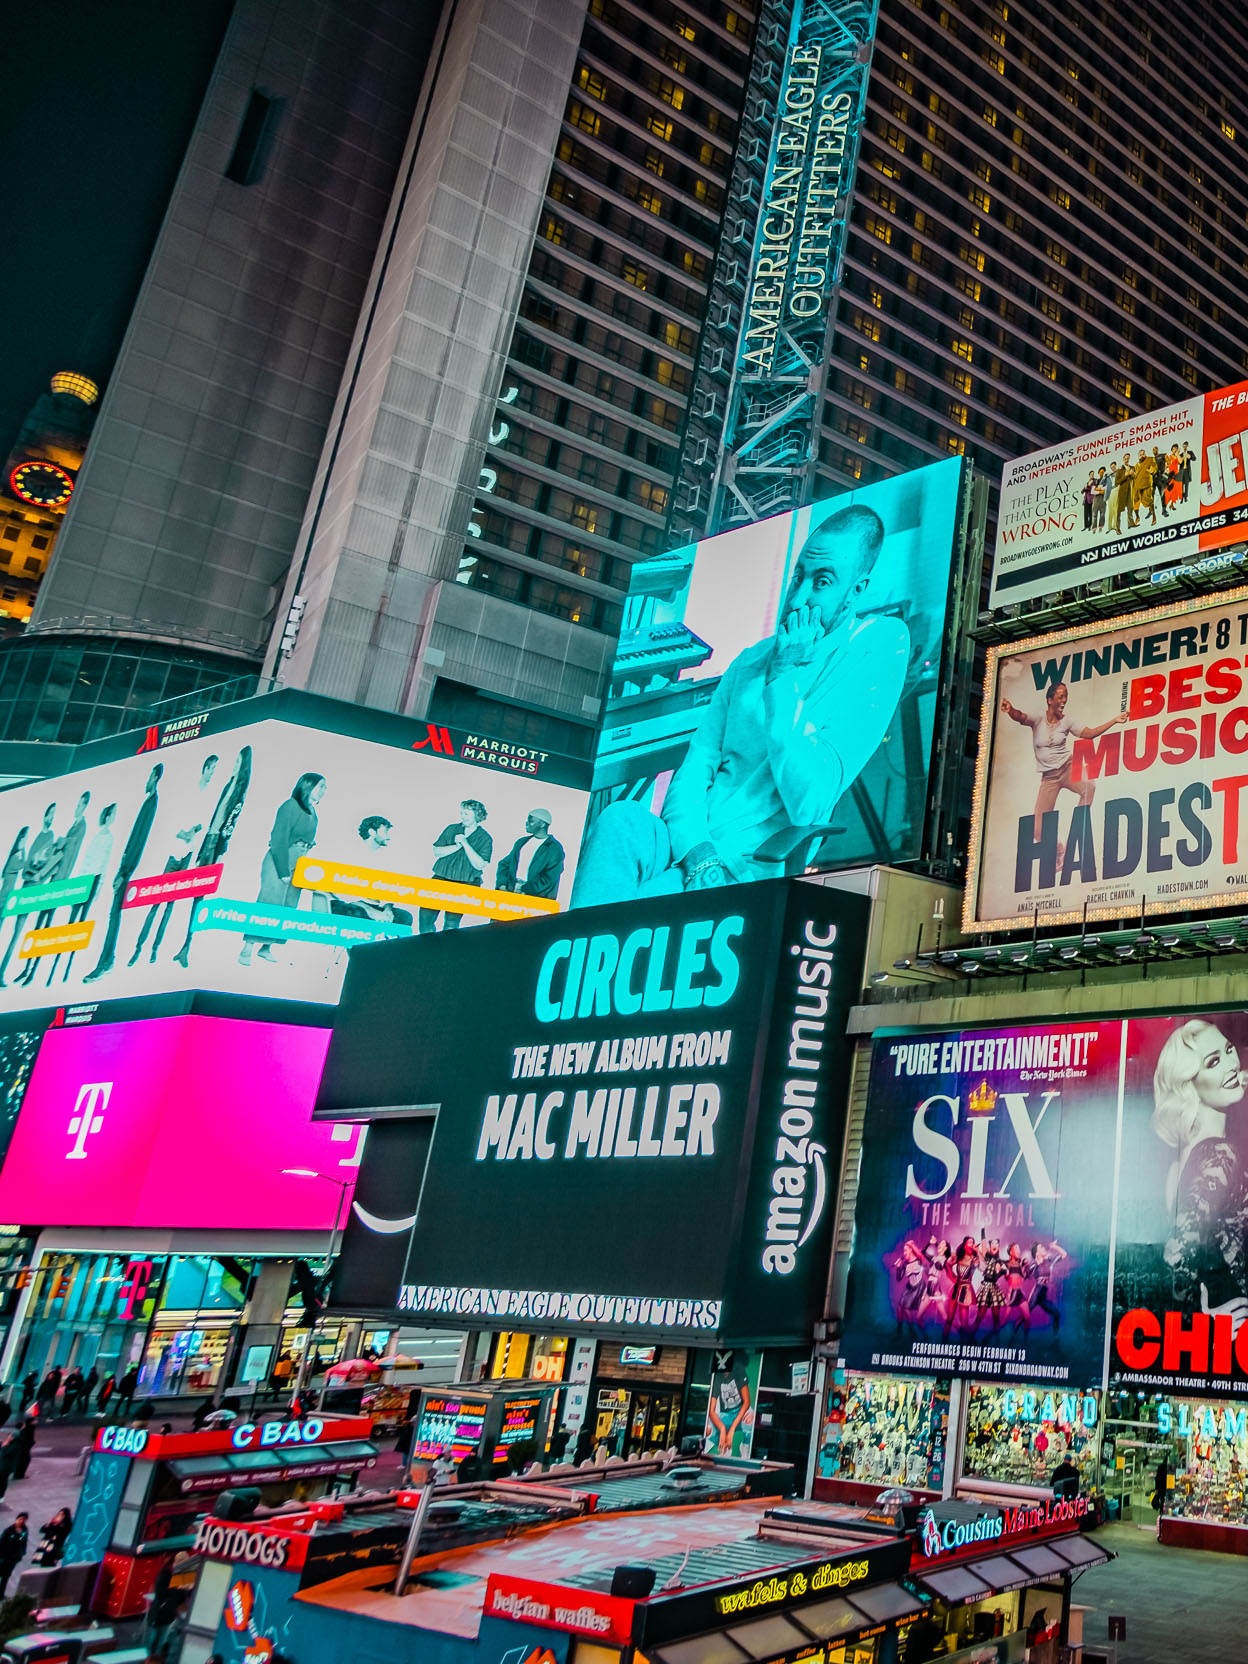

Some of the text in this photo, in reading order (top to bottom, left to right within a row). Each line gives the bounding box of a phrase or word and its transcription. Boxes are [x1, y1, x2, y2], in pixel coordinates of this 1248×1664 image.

[742, 45, 823, 371] AMERICAN EAGLE
[790, 92, 853, 318] OUTFITTERS
[1211, 395, 1234, 413] THE
[1006, 419, 1194, 488] AND INTERNATIONAL PHENOMENON
[1012, 410, 1189, 476] BROADWAY'S FUNNIEST SMASH HIT
[1004, 491, 1079, 525] THAT GOES
[1011, 477, 1074, 510] THE PLAY
[1002, 512, 1078, 545] WRONG
[1101, 541, 1130, 558] NEW
[1132, 528, 1178, 549] WORLD
[1180, 514, 1227, 536] STAGES
[1000, 537, 1074, 566] BROADWAYGOESWRONG.COM
[1031, 622, 1211, 692] WINNER!
[1216, 622, 1230, 650] 8
[1120, 681, 1129, 714] INCLUDING
[161, 727, 200, 746] MARQUIS
[165, 713, 210, 733] MARRIOTT
[464, 748, 536, 773] MARQUIS
[466, 735, 549, 762] MARRIOTT
[333, 873, 496, 909] Make design accessible to
[1086, 889, 1135, 904] RACHEL CHAVKIN
[1157, 880, 1209, 895] HADESTOWN.COM
[1035, 898, 1062, 911] MITCHELL
[249, 912, 280, 929] new
[282, 916, 337, 940] product
[340, 928, 372, 943] spec
[534, 915, 744, 1023] CIRCLES
[788, 919, 837, 1070] music
[511, 1029, 732, 1079] THE NEW ALBUM FROM
[1020, 1067, 1087, 1081] The New York Times
[65, 1082, 113, 1159] T
[475, 1083, 721, 1160] MAC MILLER
[761, 1078, 821, 1275] amazon
[922, 1202, 1036, 1227] THE MUSICAL
[398, 1285, 721, 1329] AMERICAN EAGLE OUTFITTERS
[912, 1342, 1017, 1361] PERFORMANCES BEGIN FEBRUARY
[931, 1357, 955, 1370] THEATRE
[993, 1362, 1001, 1373] ST
[1005, 1363, 1069, 1379] SIXONBROADWAY.COM
[1122, 1373, 1174, 1386] AMBASSADOR
[1175, 1377, 1206, 1389] THEATRE
[1211, 1380, 1231, 1391] 49TH
[445, 1402, 460, 1413] too
[460, 1404, 487, 1415] proud
[1003, 1389, 1248, 1439] GRAND SLAM
[102, 1426, 148, 1453] C BAO
[232, 1419, 324, 1448] C BAO
[502, 1419, 535, 1433] proud
[942, 1495, 1090, 1549] Cousins Maine Lobster
[193, 1523, 290, 1566] HOTDOGS
[720, 1560, 869, 1614] wafels & dinges
[493, 1589, 612, 1632] belgian waffles
